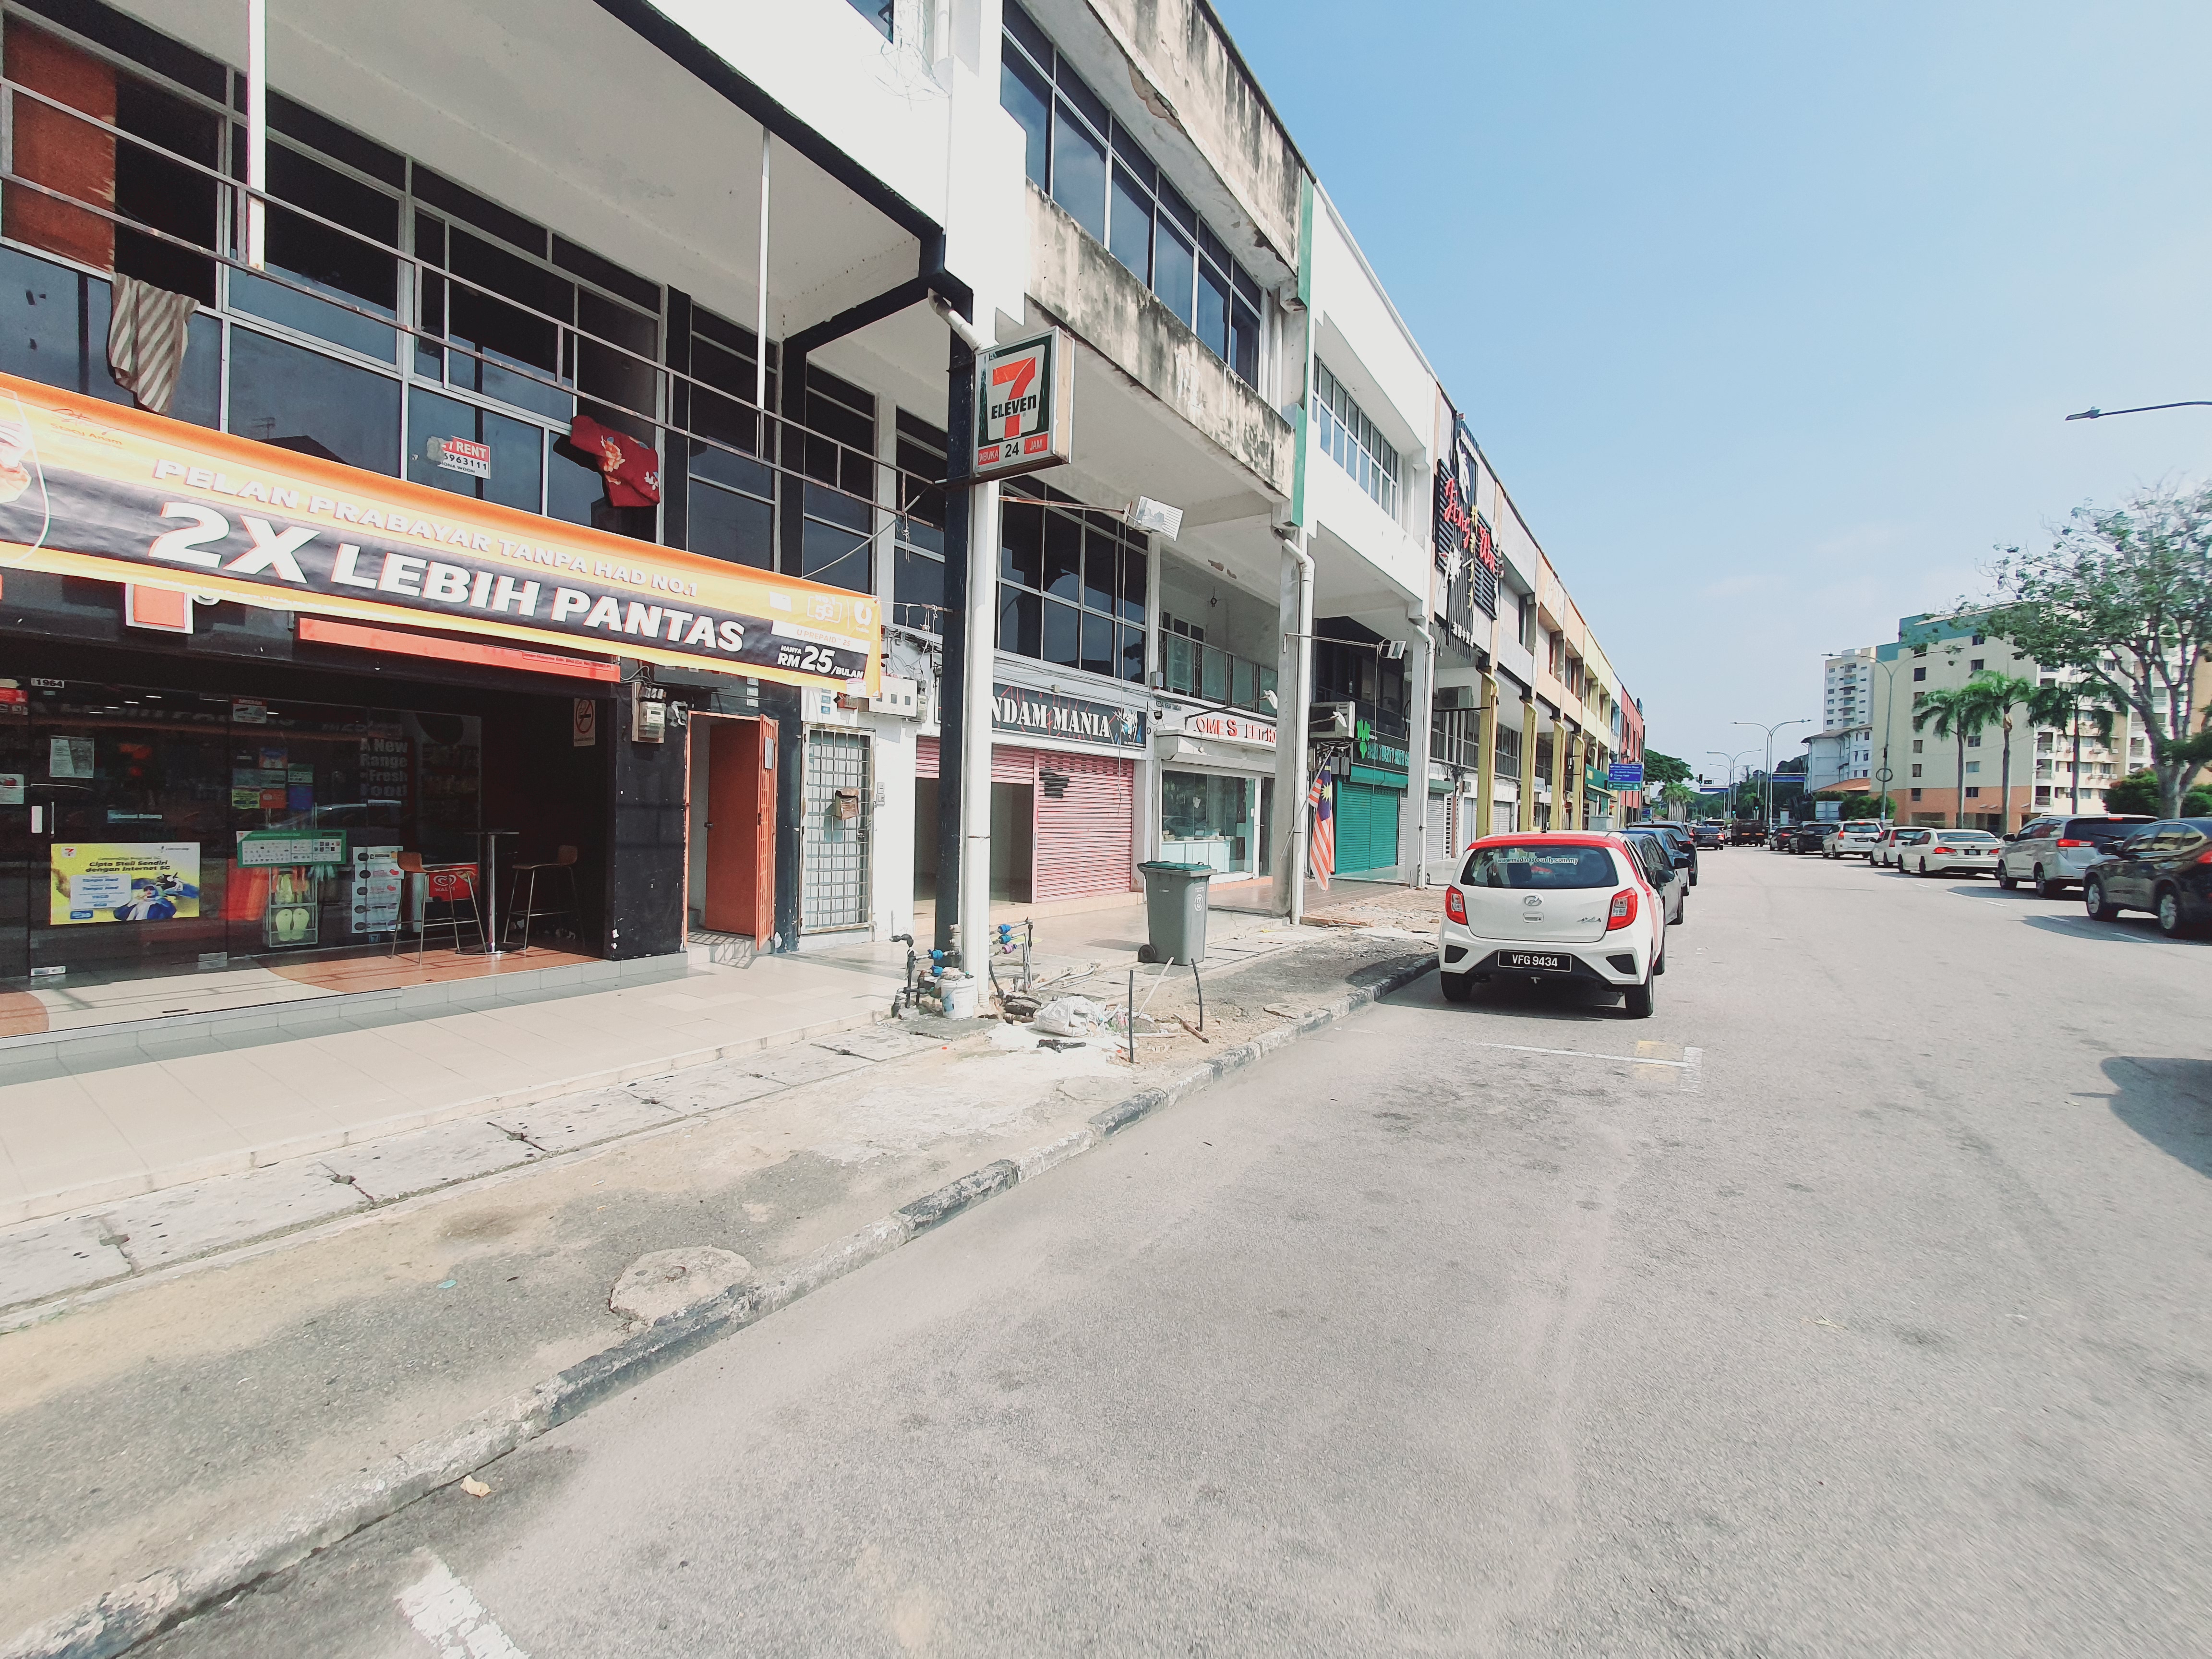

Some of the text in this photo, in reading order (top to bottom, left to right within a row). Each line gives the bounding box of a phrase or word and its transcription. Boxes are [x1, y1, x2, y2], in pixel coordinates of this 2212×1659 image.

[88, 433, 123, 445] Anam
[1029, 439, 1042, 451] JAM
[456, 441, 487, 459] RENT
[1005, 441, 1020, 458] 24
[153, 459, 698, 597] PELAN PRABAYAR TANPA HAD NO.1
[148, 502, 746, 653] 2X LEBIH PANTAS
[815, 594, 836, 605] NO.1
[814, 603, 834, 621] 5G
[781, 645, 802, 655] HANYA
[777, 652, 801, 669] RM
[800, 645, 835, 674] 25
[36, 679, 62, 687] 1964
[1052, 706, 1111, 738] MANIA
[1512, 954, 1558, 967] VFG 9434
